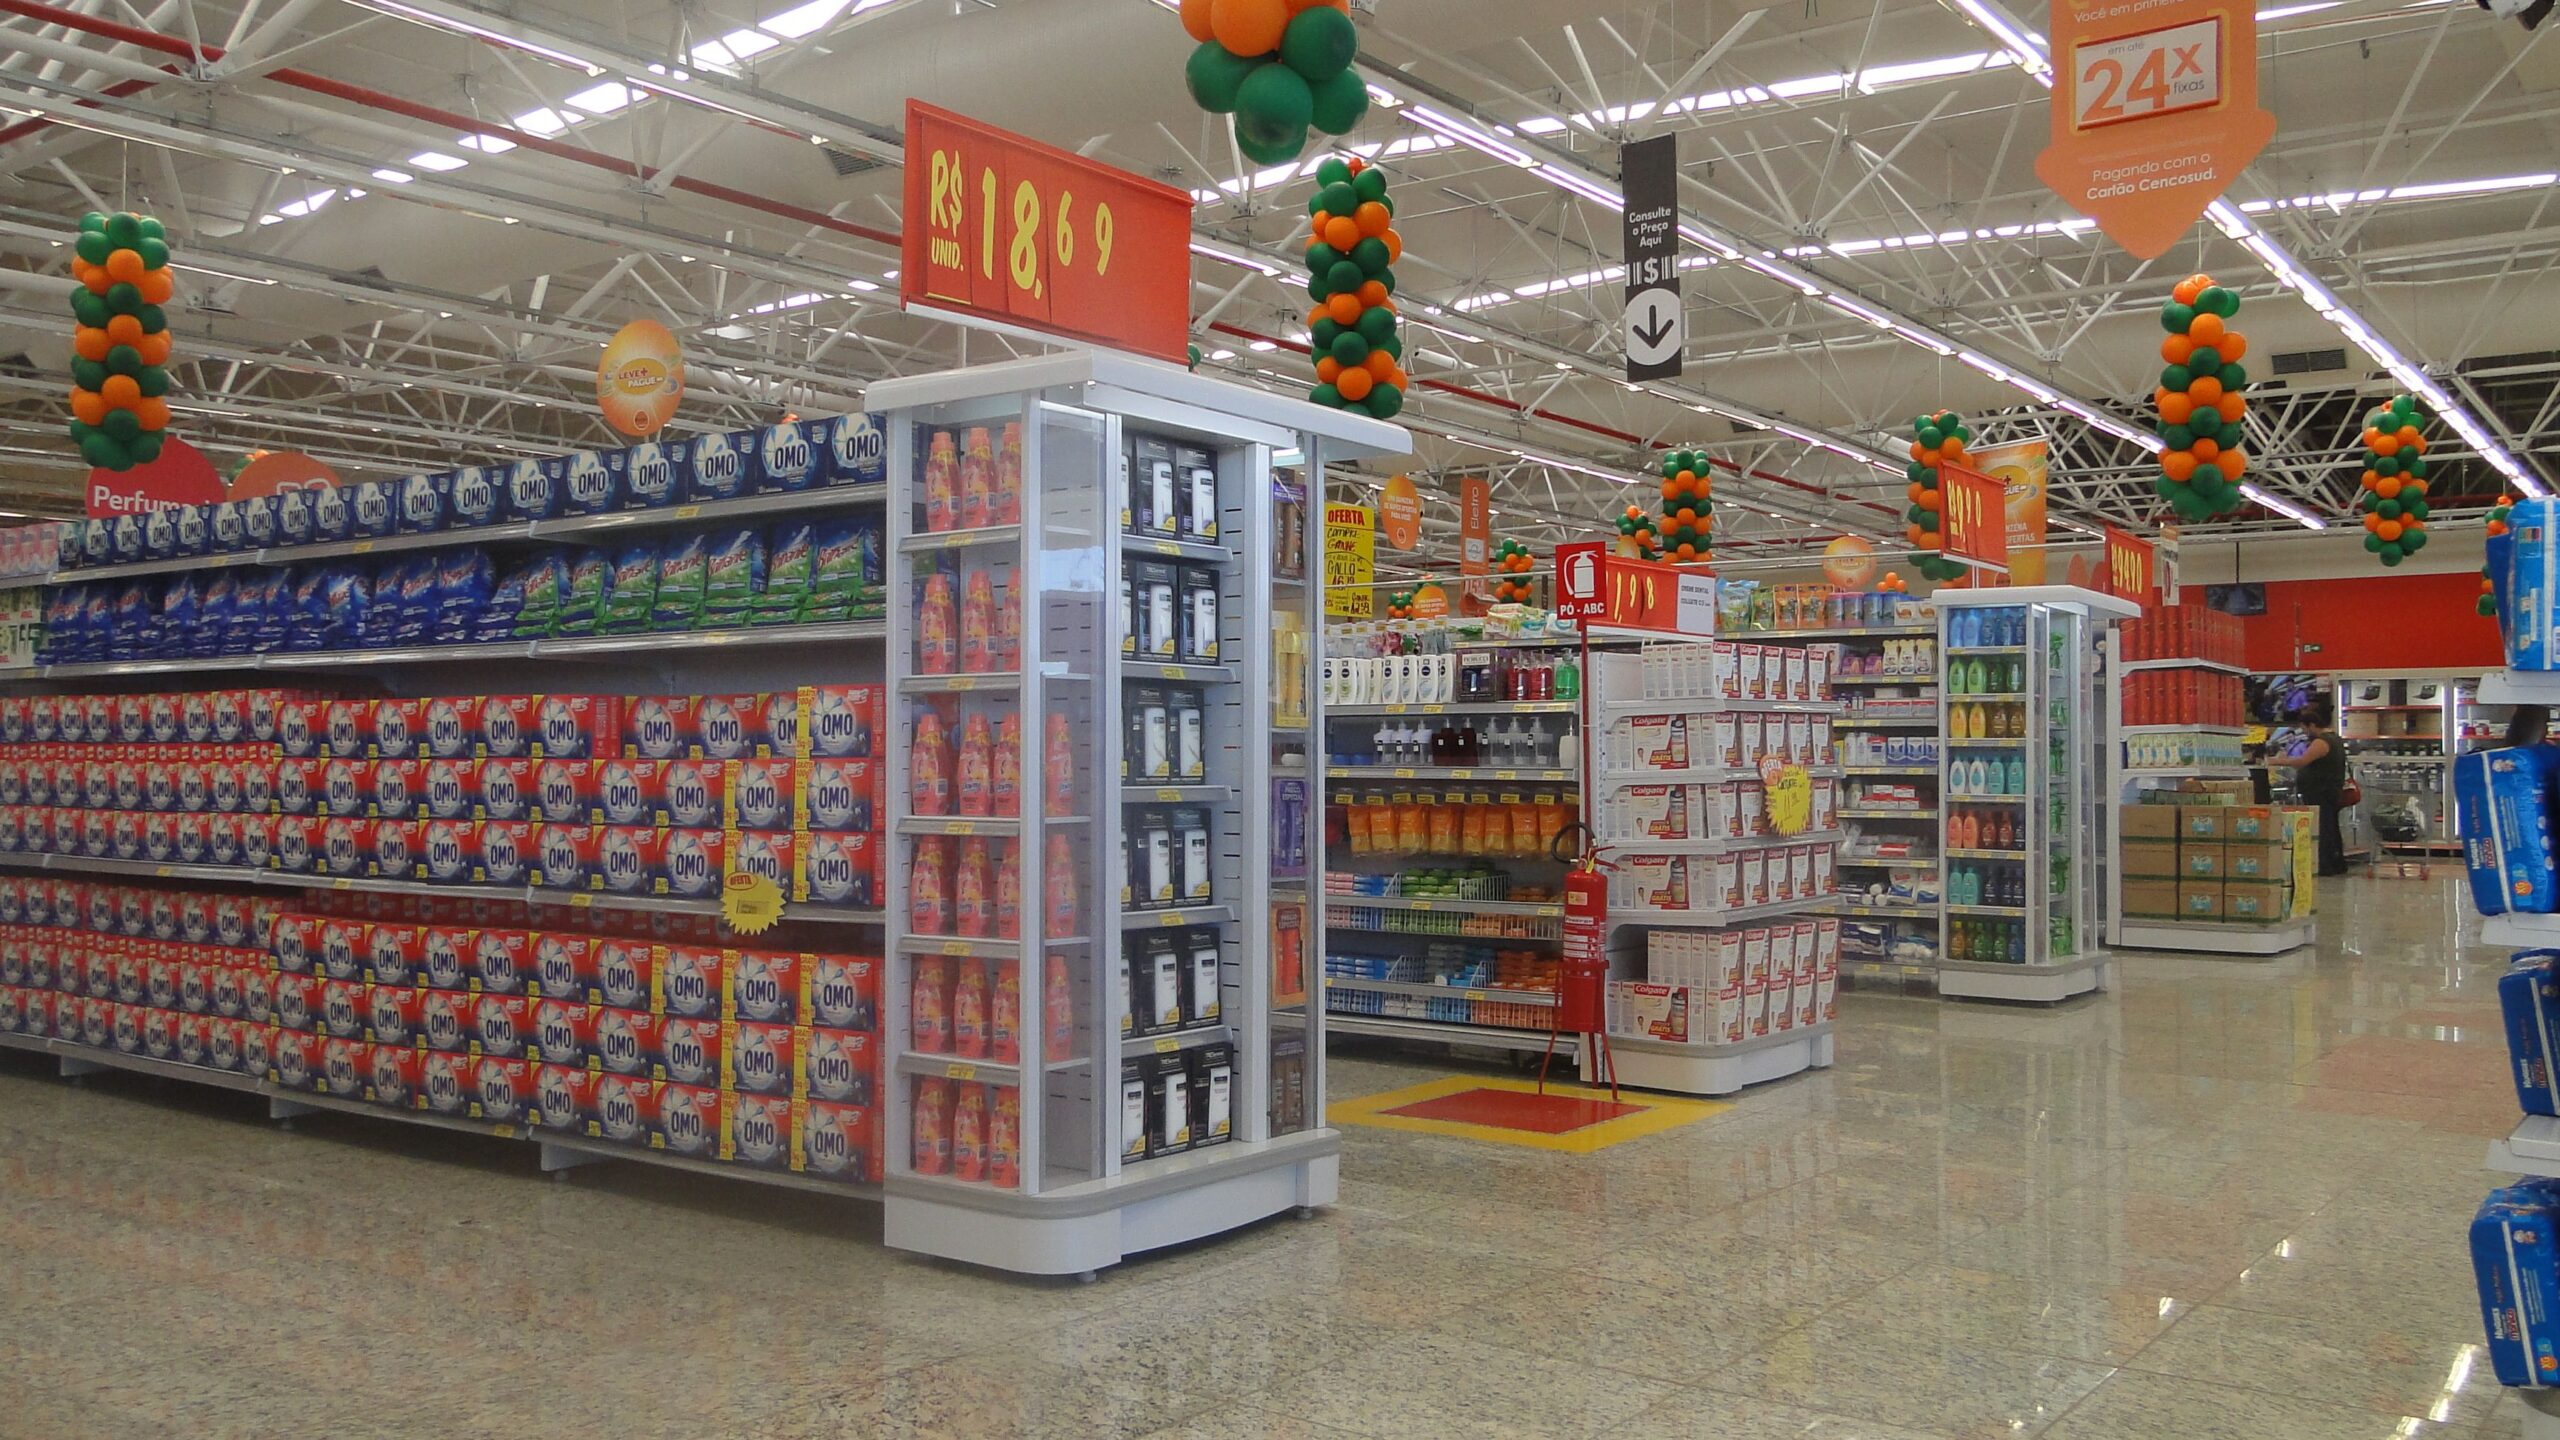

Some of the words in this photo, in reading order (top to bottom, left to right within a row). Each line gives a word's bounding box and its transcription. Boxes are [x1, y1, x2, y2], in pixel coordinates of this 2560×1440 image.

[2075, 9, 2106, 22] Você
[2110, 3, 2131, 15] em
[2107, 46, 2125, 55] em
[2127, 41, 2144, 51] até
[2173, 79, 2204, 95] fixas
[2092, 161, 2160, 182] Pagando
[2163, 157, 2197, 171] com
[2200, 153, 2210, 163] o
[930, 150, 963, 237] R$
[2086, 183, 2136, 200] Cartão
[2139, 168, 2217, 191] Cencosud.
[1629, 207, 1671, 223] Consulte
[1632, 227, 1639, 236] o
[1640, 220, 1668, 238] Preço
[1639, 236, 1662, 248] Aqui
[931, 237, 964, 272] UNID.
[774, 444, 807, 471] OMO
[845, 433, 880, 460] OMO
[639, 462, 668, 487] OMO
[705, 453, 735, 480] OMO
[520, 478, 546, 503] OMO
[578, 471, 607, 496] OMO
[2004, 484, 2020, 496] GUE
[411, 492, 435, 515] OMO
[463, 485, 489, 508] OMO
[1470, 486, 1479, 530] Eletro
[364, 498, 385, 519] OMO
[1328, 510, 1365, 526] OFERTA
[1560, 602, 1574, 616] PÓ
[1583, 603, 1604, 614] ABC
[384, 722, 405, 743] OMO
[436, 721, 459, 742] OMO
[492, 719, 515, 742] OMO
[550, 718, 574, 741] OMO
[645, 721, 671, 744] OMO
[709, 719, 738, 743] OMO
[777, 718, 797, 740] OM
[820, 711, 853, 737] OMO
[1634, 716, 1668, 726] Colgate
[333, 781, 353, 800] OMO
[382, 783, 403, 802] OMO
[435, 781, 459, 802] OMO
[491, 782, 515, 803] OMO
[549, 784, 572, 807] OMO
[611, 785, 637, 808] OMO
[675, 785, 704, 809] OMO
[746, 785, 774, 809] OMO
[818, 784, 849, 810] OMO
[1634, 786, 1666, 796] Colgate
[331, 839, 352, 858] OMO
[384, 841, 404, 860] OMO
[434, 842, 458, 863] OMO
[491, 845, 515, 866] OMO
[550, 847, 574, 870] OMO
[611, 851, 637, 875] OMO
[676, 853, 704, 877] OMO
[746, 856, 777, 880] OMO
[818, 858, 849, 882] OMO
[1634, 857, 1667, 866] Colgate
[379, 950, 401, 969] OMO
[434, 952, 456, 973] OMO
[486, 956, 511, 977] OMO
[547, 959, 571, 982] OMO
[607, 966, 634, 990] OMO
[676, 975, 704, 998] OMO
[745, 979, 776, 1003] OMO
[823, 984, 854, 1008] OMO
[1635, 985, 1670, 996] Colgate
[330, 1003, 351, 1022] OMO
[378, 1010, 399, 1029] OMO
[432, 1014, 455, 1035] OMO
[486, 1020, 511, 1041] OMO
[544, 1025, 571, 1047] OMO
[608, 1035, 634, 1058] OMO
[672, 1042, 700, 1066] OMO
[331, 1061, 352, 1080] OMO
[743, 1049, 774, 1073] OMO
[818, 1057, 849, 1081] OMO
[379, 1068, 398, 1089] OMO
[433, 1076, 455, 1097] OMO
[487, 1082, 510, 1105] OMO
[547, 1090, 570, 1113] OMO
[608, 1102, 634, 1125] OMO
[671, 1111, 700, 1135] OMO
[743, 1120, 774, 1144] OMO
[814, 1131, 845, 1155] OMO
